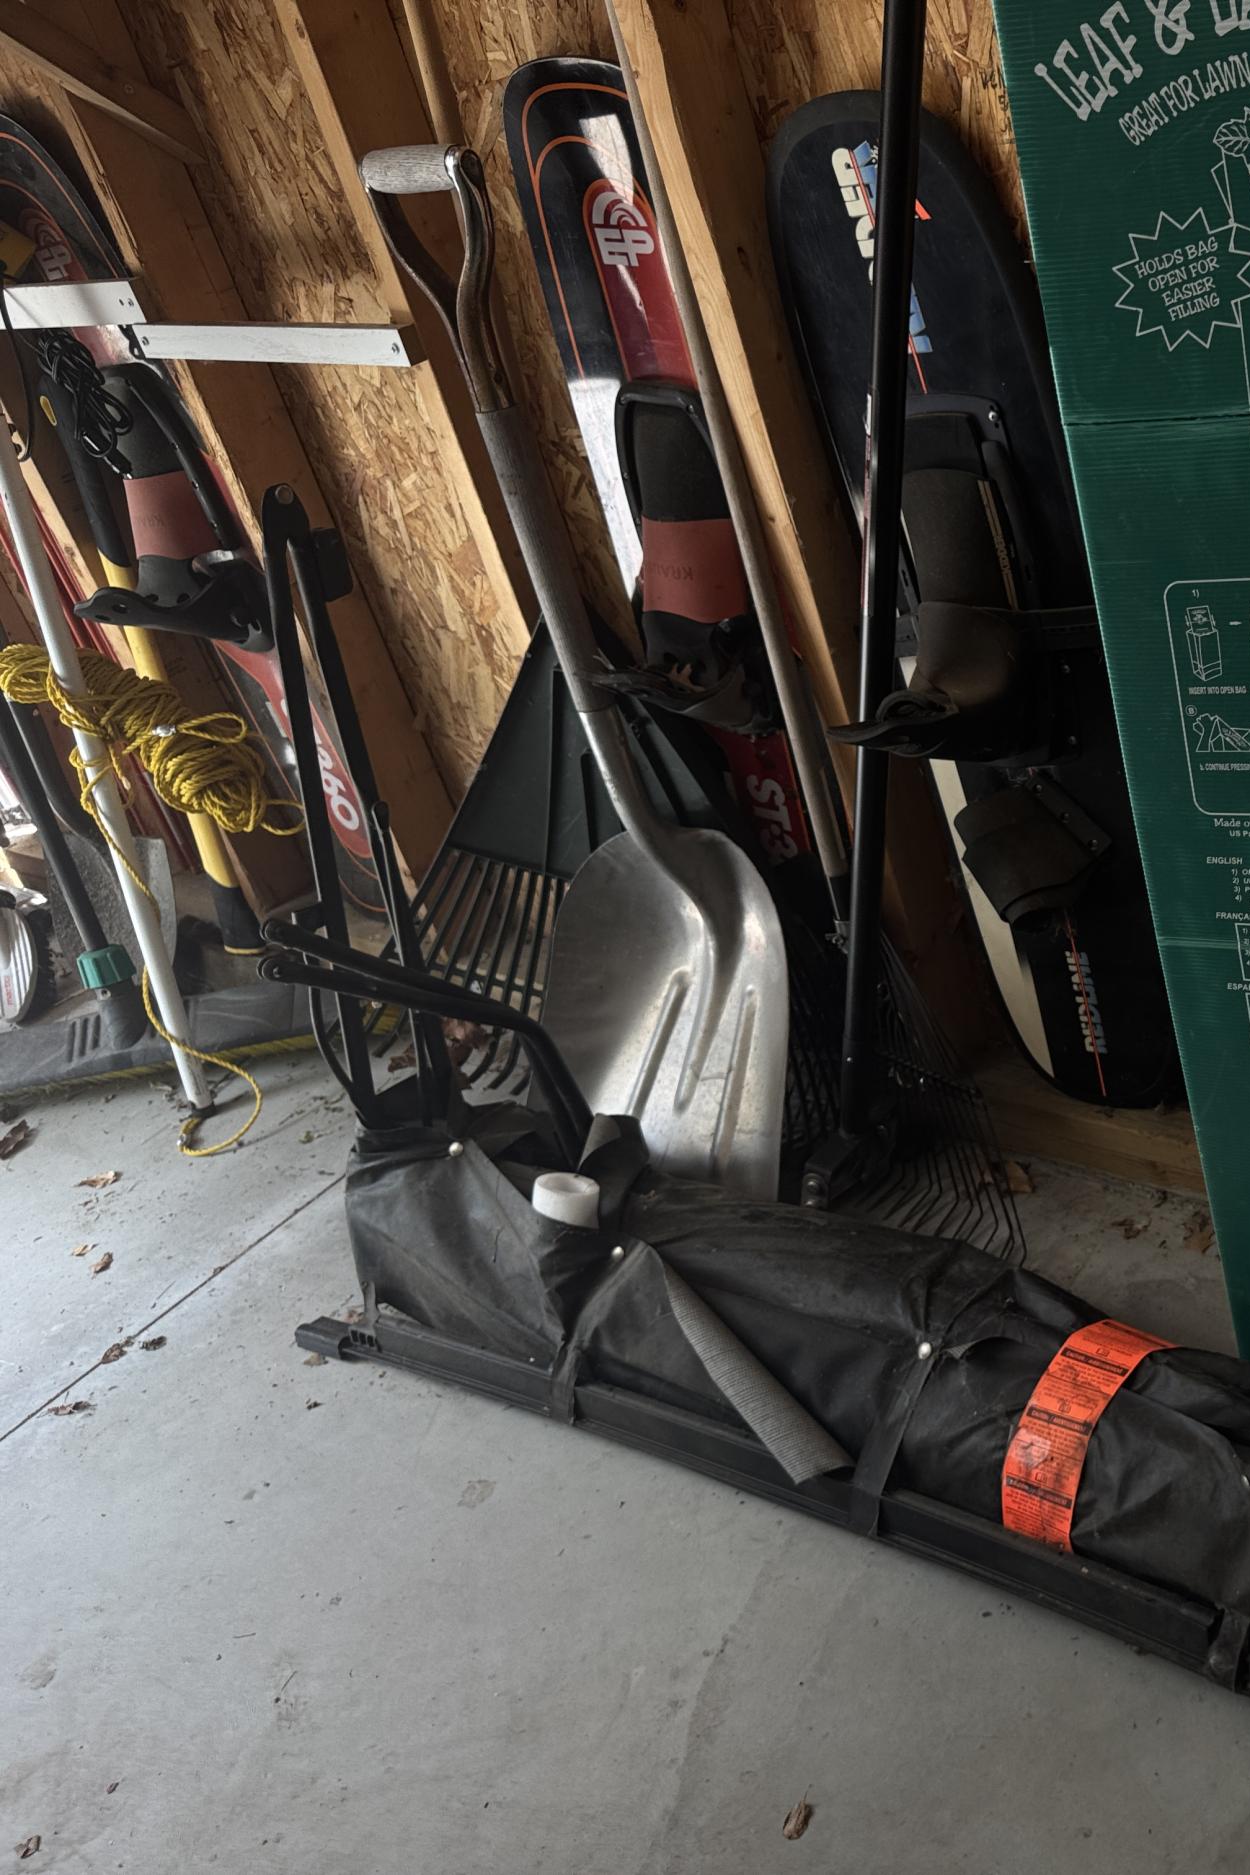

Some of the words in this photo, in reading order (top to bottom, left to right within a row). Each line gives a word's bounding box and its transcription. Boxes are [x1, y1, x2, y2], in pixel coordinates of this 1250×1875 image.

[1034, 1, 1144, 121] LEAF
[1145, 0, 1195, 55] &
[1118, 92, 1169, 146] GREAT
[1160, 74, 1200, 118] FOR
[1134, 248, 1184, 278] HOLDS
[1185, 236, 1218, 259] BAG
[1148, 266, 1187, 292] OPEN
[1188, 256, 1220, 277] FOR
[1161, 276, 1216, 306] EASIER
[1168, 292, 1220, 321] FILLING
[1192, 588, 1199, 598] 1)
[1213, 818, 1240, 827] Made
[1229, 830, 1241, 838] US
[1231, 868, 1238, 876] 1)
